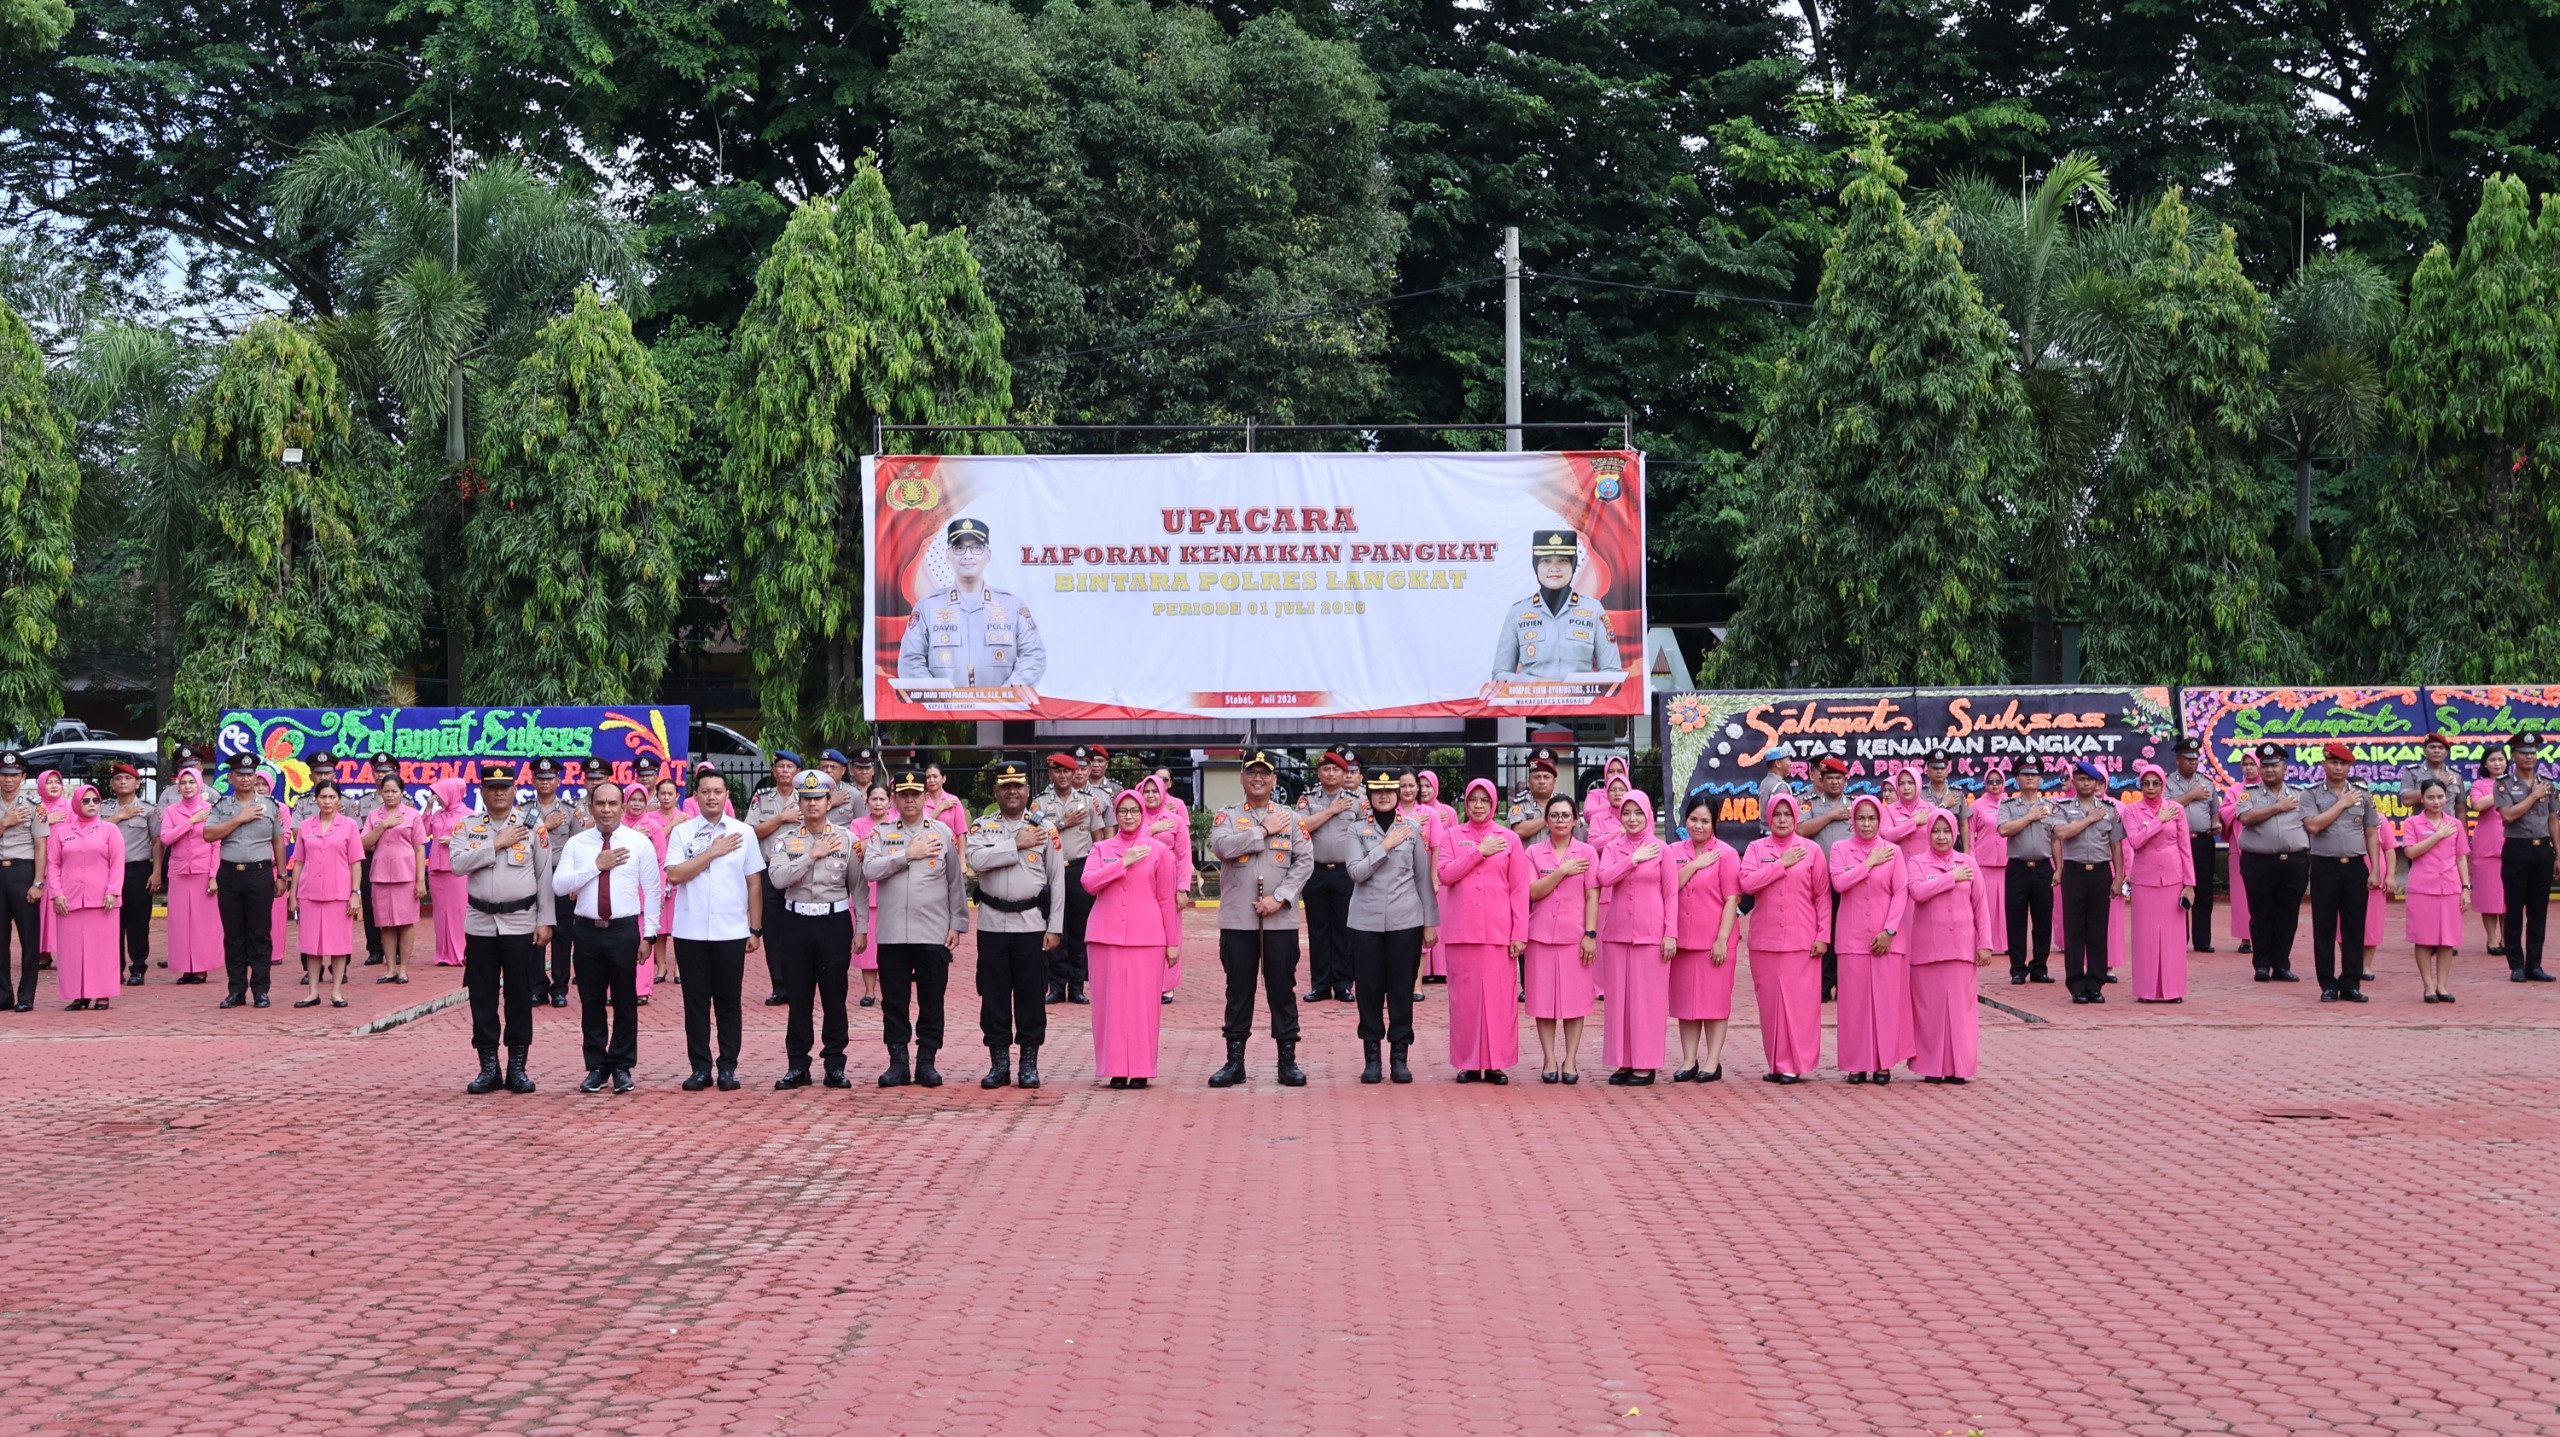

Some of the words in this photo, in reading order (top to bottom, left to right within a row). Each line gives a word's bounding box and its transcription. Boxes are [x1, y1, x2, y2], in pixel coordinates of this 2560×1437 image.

[1160, 505, 1359, 534] UPACARA
[1020, 543, 1171, 565] LAPORAN
[1179, 542, 1342, 564] KENAIKAN
[1349, 540, 1499, 563] PANGKAT
[1054, 571, 1190, 592] BINTARA
[1199, 570, 1317, 591] POLRES
[1326, 569, 1467, 590] LANGKAT
[1152, 602, 1242, 616] PERIODE
[1247, 602, 1268, 615] 01
[1275, 601, 1316, 618] JULI
[1321, 601, 1366, 615] 2026
[932, 624, 958, 632] DAVID
[986, 623, 1012, 631] POLRI
[1518, 620, 1543, 629] VIVIEN
[1569, 619, 1594, 628] POLRI
[1225, 694, 1254, 705] Stabat,
[1260, 695, 1275, 704] Juli
[1277, 694, 1297, 704] 2026
[332, 708, 478, 760] Selamat
[474, 709, 594, 757] Sukses
[1780, 739, 1848, 758] ATAS
[1991, 734, 2122, 756] PANGKAT
